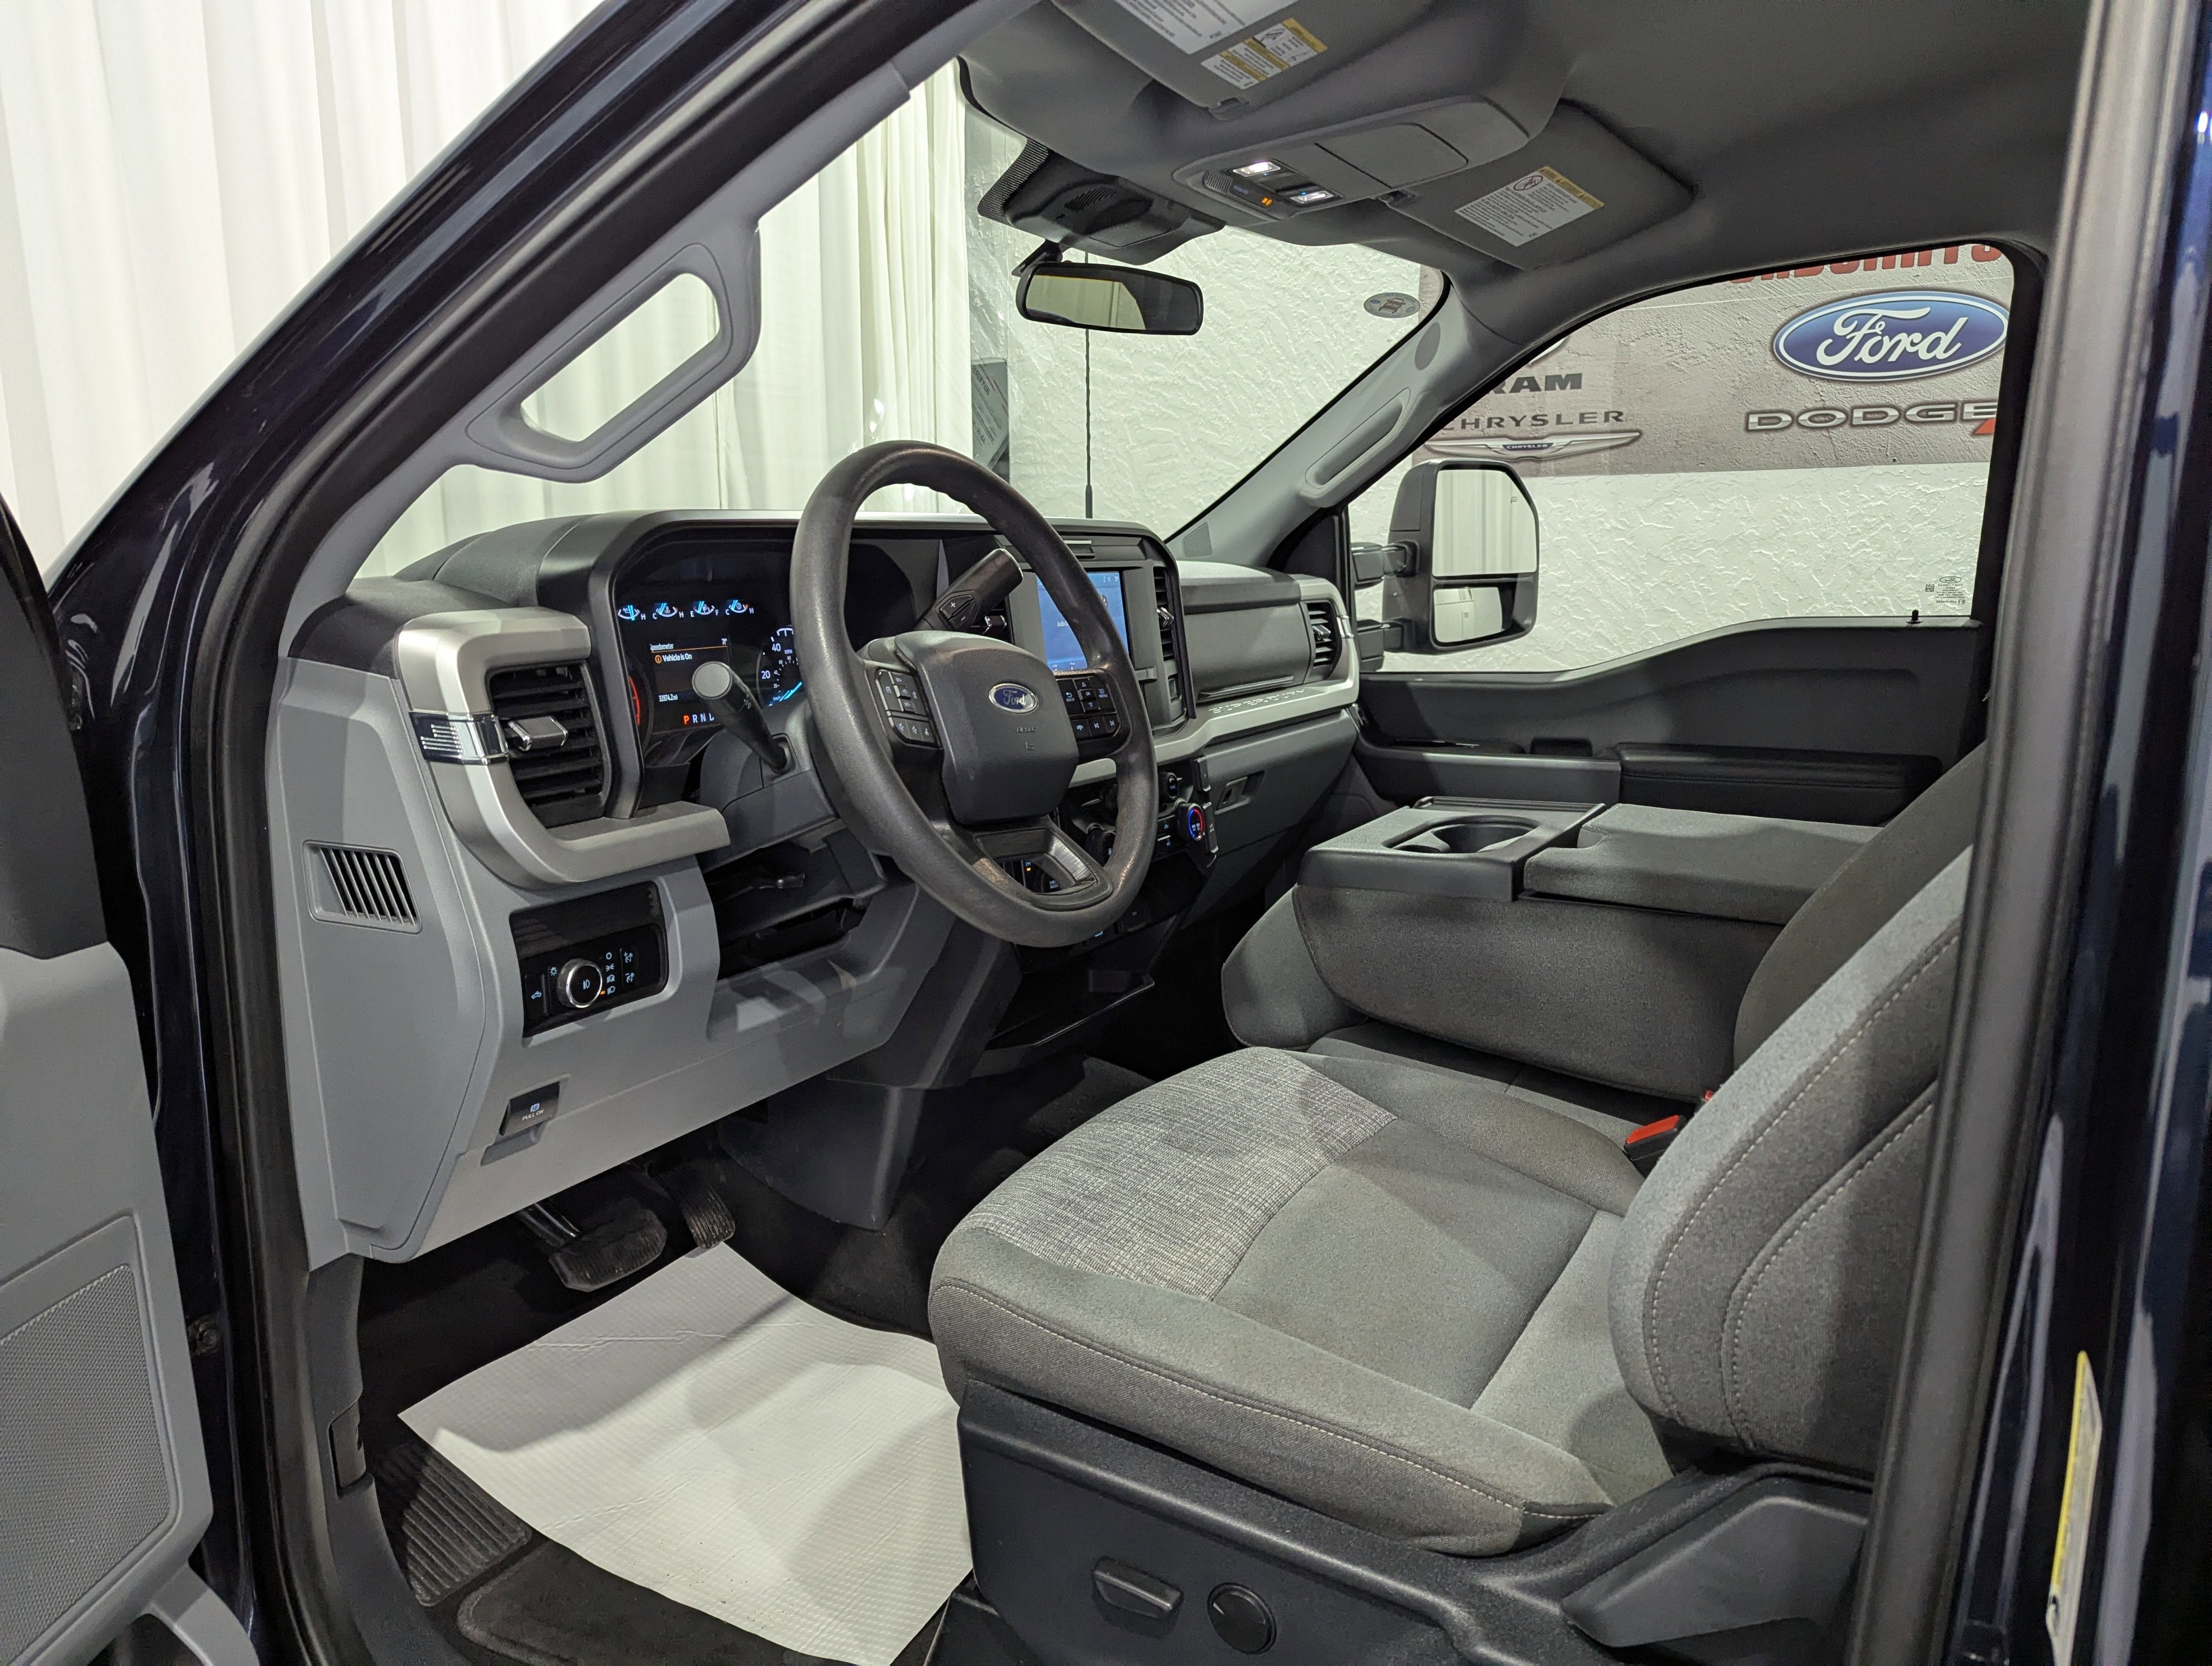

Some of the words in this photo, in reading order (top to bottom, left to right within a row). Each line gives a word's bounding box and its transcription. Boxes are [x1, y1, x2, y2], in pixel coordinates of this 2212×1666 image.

[1817, 307, 1968, 366] Ford
[1442, 411, 1625, 430] HRYSLER
[1747, 401, 1997, 431] DODGE
[650, 643, 674, 652] peedometer
[771, 643, 781, 652] 40
[662, 654, 680, 662] Vehicle
[761, 670, 770, 680] 20
[1003, 689, 1026, 706] Ford
[684, 715, 689, 725] P
[692, 714, 698, 723] R
[700, 713, 706, 723] N
